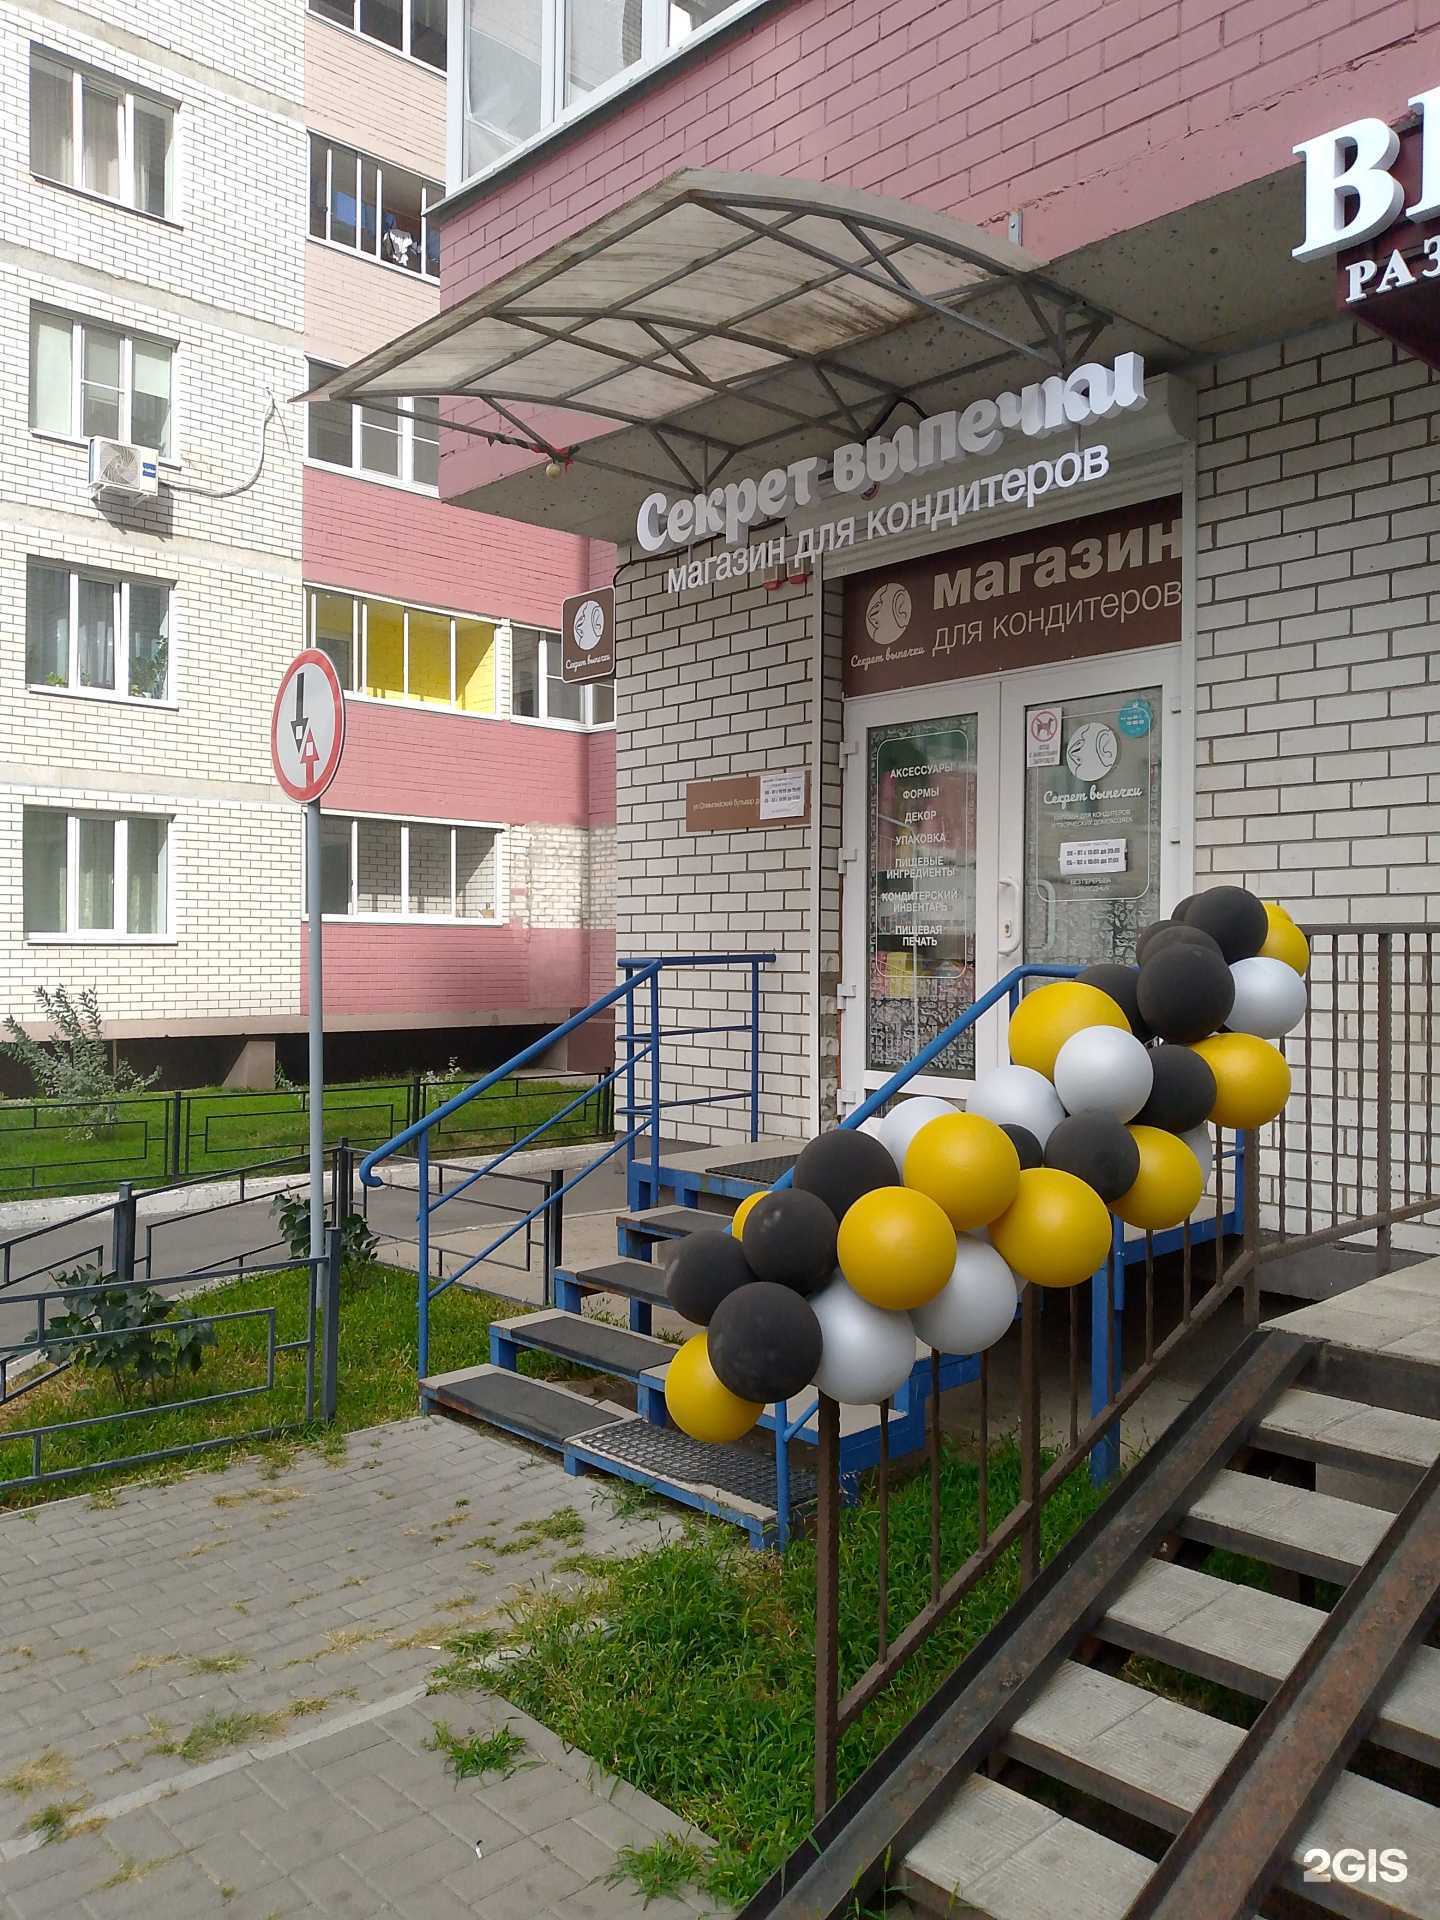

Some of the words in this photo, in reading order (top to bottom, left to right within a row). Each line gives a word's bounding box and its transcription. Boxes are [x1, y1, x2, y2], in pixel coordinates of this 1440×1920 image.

[637, 457, 824, 551] Секрет
[833, 352, 1147, 494] выпечки
[667, 537, 786, 594] магазин
[794, 517, 856, 568] для
[867, 444, 1110, 531] кондитеров
[932, 518, 1183, 610] магазин
[993, 580, 1183, 639] кондитеров
[932, 620, 983, 656] для
[850, 655, 884, 671] Секрет
[890, 762, 953, 779] АКСЕССУАРЫ
[902, 786, 940, 799] ФОРМЫ
[1043, 790, 1088, 809] Секрет
[1089, 784, 1142, 801] выпечки
[904, 810, 937, 825] ДЕКОР
[895, 832, 946, 846] УПАКОВКА
[895, 856, 944, 868] ПИЩЕВЫЕ
[886, 866, 956, 880] ИНГРЕДИЕНТЫ
[881, 888, 958, 902] КОНДИТЕРСКИЙ
[895, 925, 942, 936] ПИЩЕВАЯ
[902, 936, 938, 947] ПЕЧАТЬ
